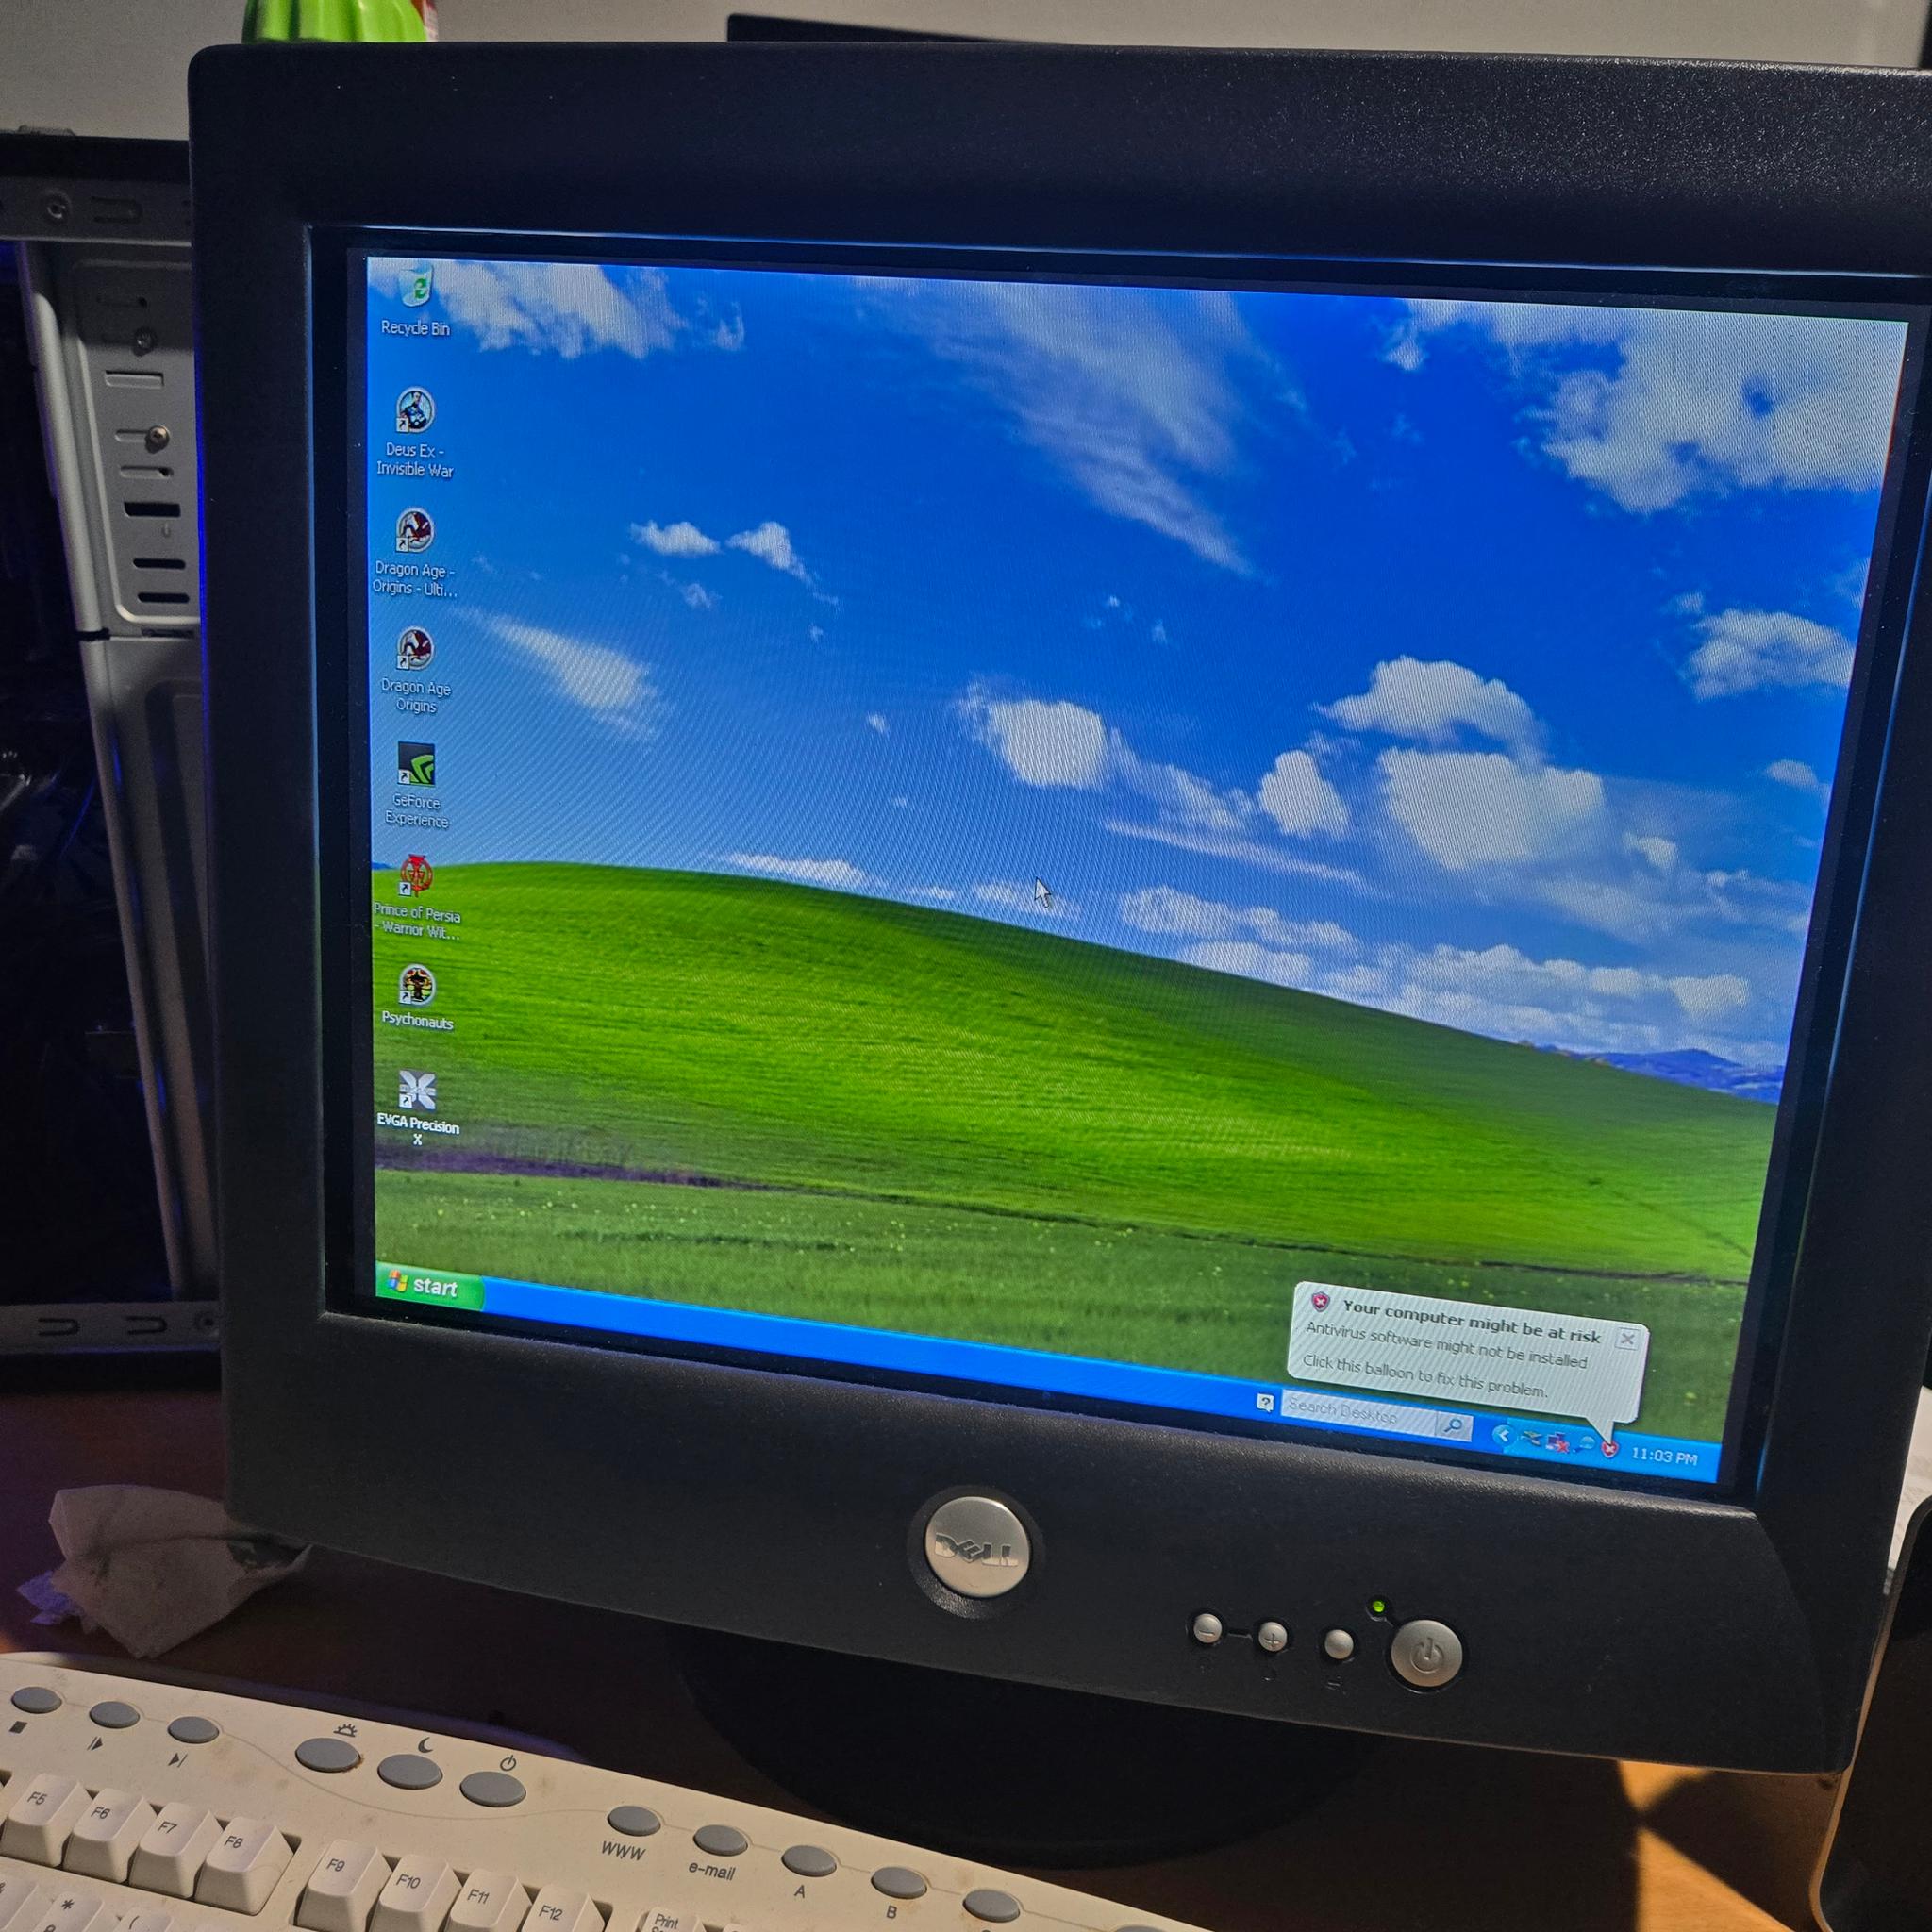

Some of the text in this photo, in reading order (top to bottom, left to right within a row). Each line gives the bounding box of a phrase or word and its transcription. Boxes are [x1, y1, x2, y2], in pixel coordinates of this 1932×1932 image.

[381, 320, 451, 338] Recycle Bin
[386, 441, 417, 457] Deus
[420, 443, 435, 458] Ex
[377, 460, 454, 478] Invisible War
[375, 560, 419, 577] Dragon
[422, 563, 446, 579] Age
[373, 579, 413, 597] Origins
[381, 677, 452, 698] Dragon Age
[396, 697, 438, 715] Origins
[392, 792, 441, 809] GeForce
[385, 810, 449, 828] Experience
[374, 901, 461, 924] Prince of Persia
[382, 921, 424, 937] Warrior
[381, 1010, 454, 1031] Psychonauts
[377, 1112, 460, 1135] EVGA Precision
[412, 1133, 423, 1146] X
[413, 1278, 458, 1298] start
[1343, 1300, 1603, 1344] Your computer might be at risk
[1306, 1322, 1589, 1369] Antivirus software might not be installed
[1303, 1354, 1548, 1398] Click this balloon to fix this problem.
[1289, 1395, 1397, 1425] Search Desktop
[1632, 1447, 1698, 1466] 11:03 PM
[935, 1532, 1019, 1567] DELL
[26, 1791, 48, 1806] F5
[91, 1807, 110, 1820] F6
[158, 1821, 178, 1834] F7
[225, 1835, 244, 1849] F8
[326, 1858, 345, 1872] F9
[688, 1862, 737, 1881] e-mail
[395, 1874, 421, 1890] F10
[467, 1889, 490, 1905] F11
[793, 1885, 806, 1899] A
[538, 1906, 564, 1922] F12
[654, 1913, 679, 1930] Print
[886, 1905, 898, 1920] B
